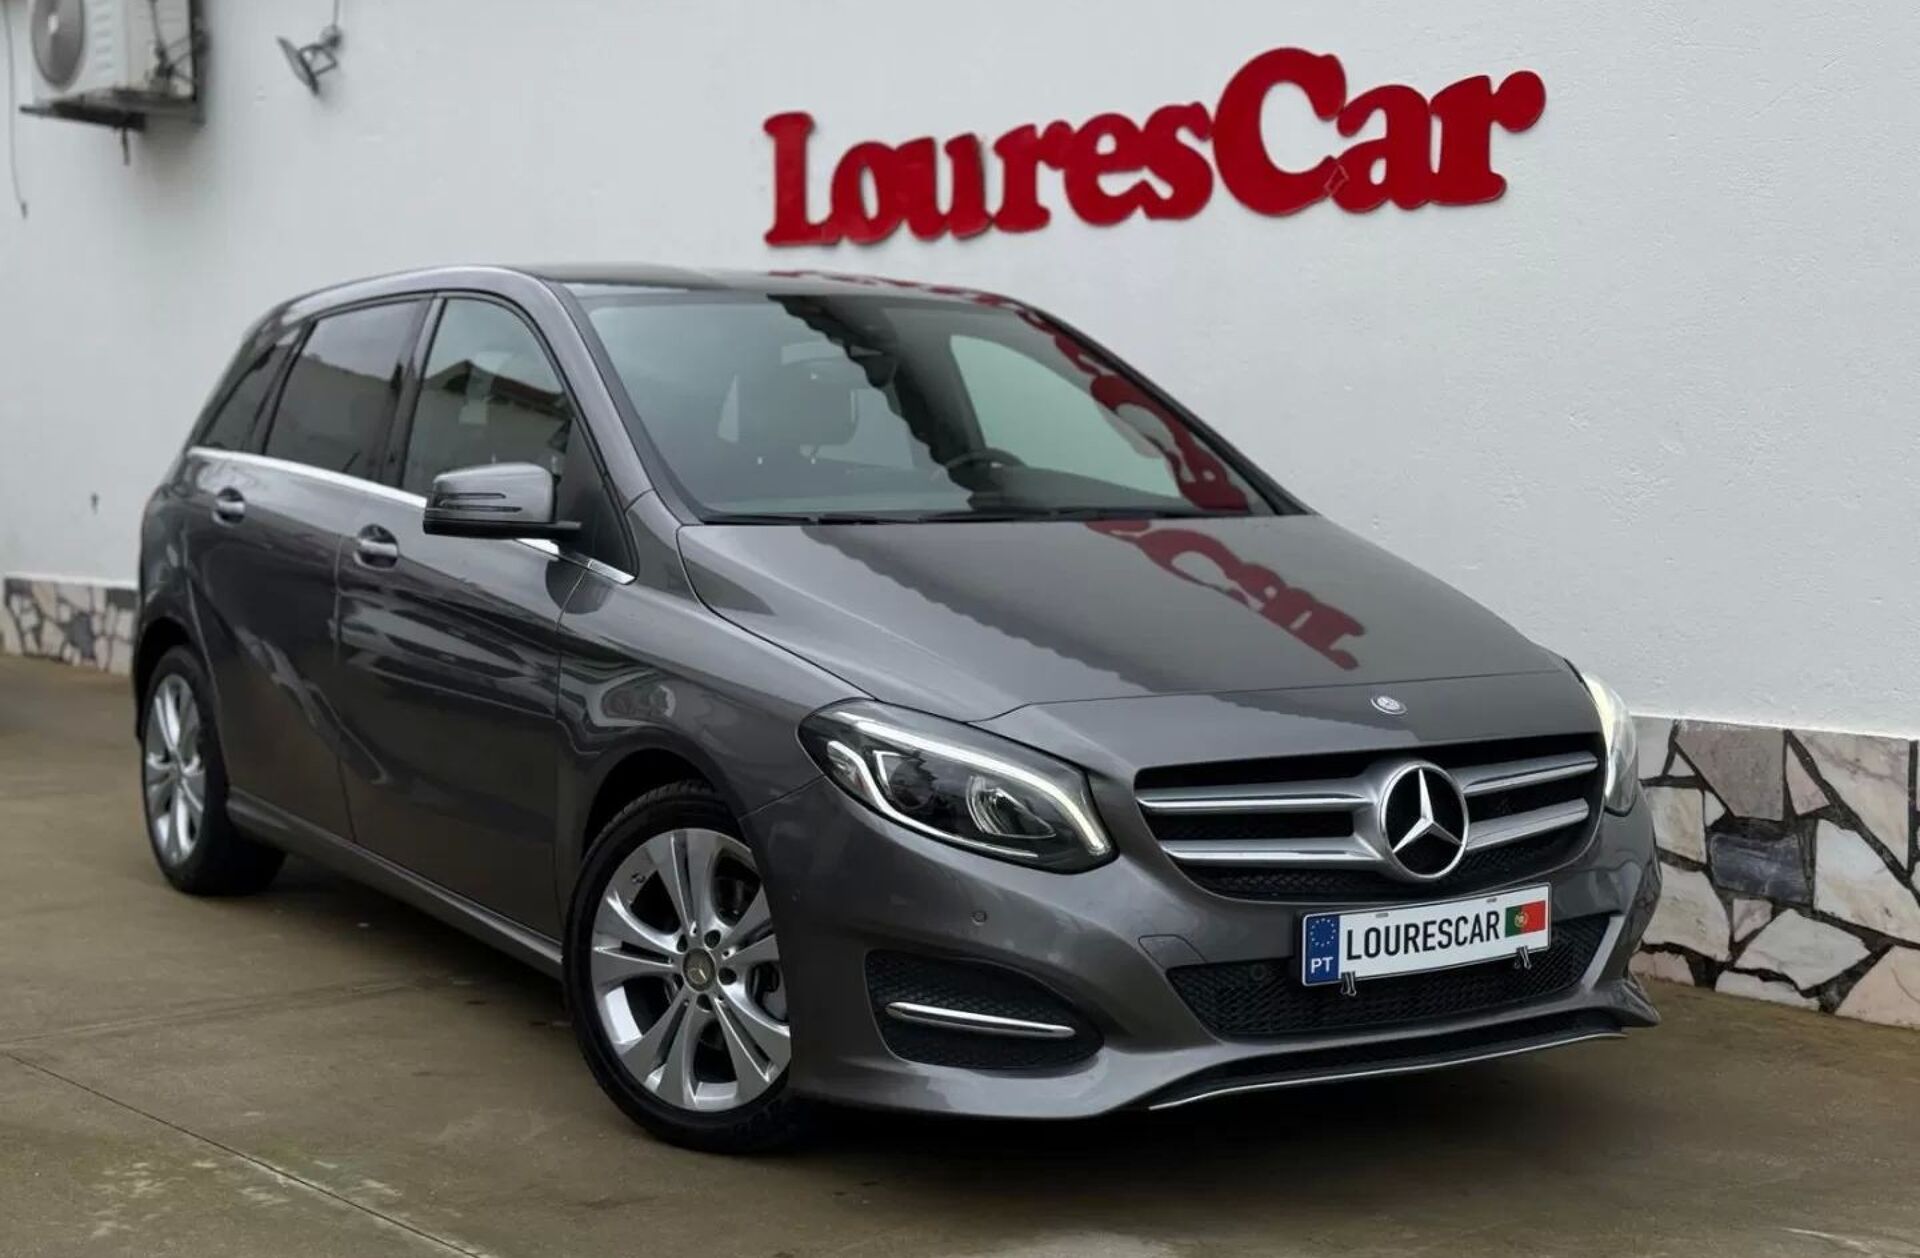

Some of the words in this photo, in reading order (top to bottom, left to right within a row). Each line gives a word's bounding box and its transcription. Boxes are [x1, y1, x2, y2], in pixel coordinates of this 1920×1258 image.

[764, 47, 1546, 248] LouresCar
[1346, 911, 1500, 960] LOURESCAR
[1310, 956, 1334, 974] PT
